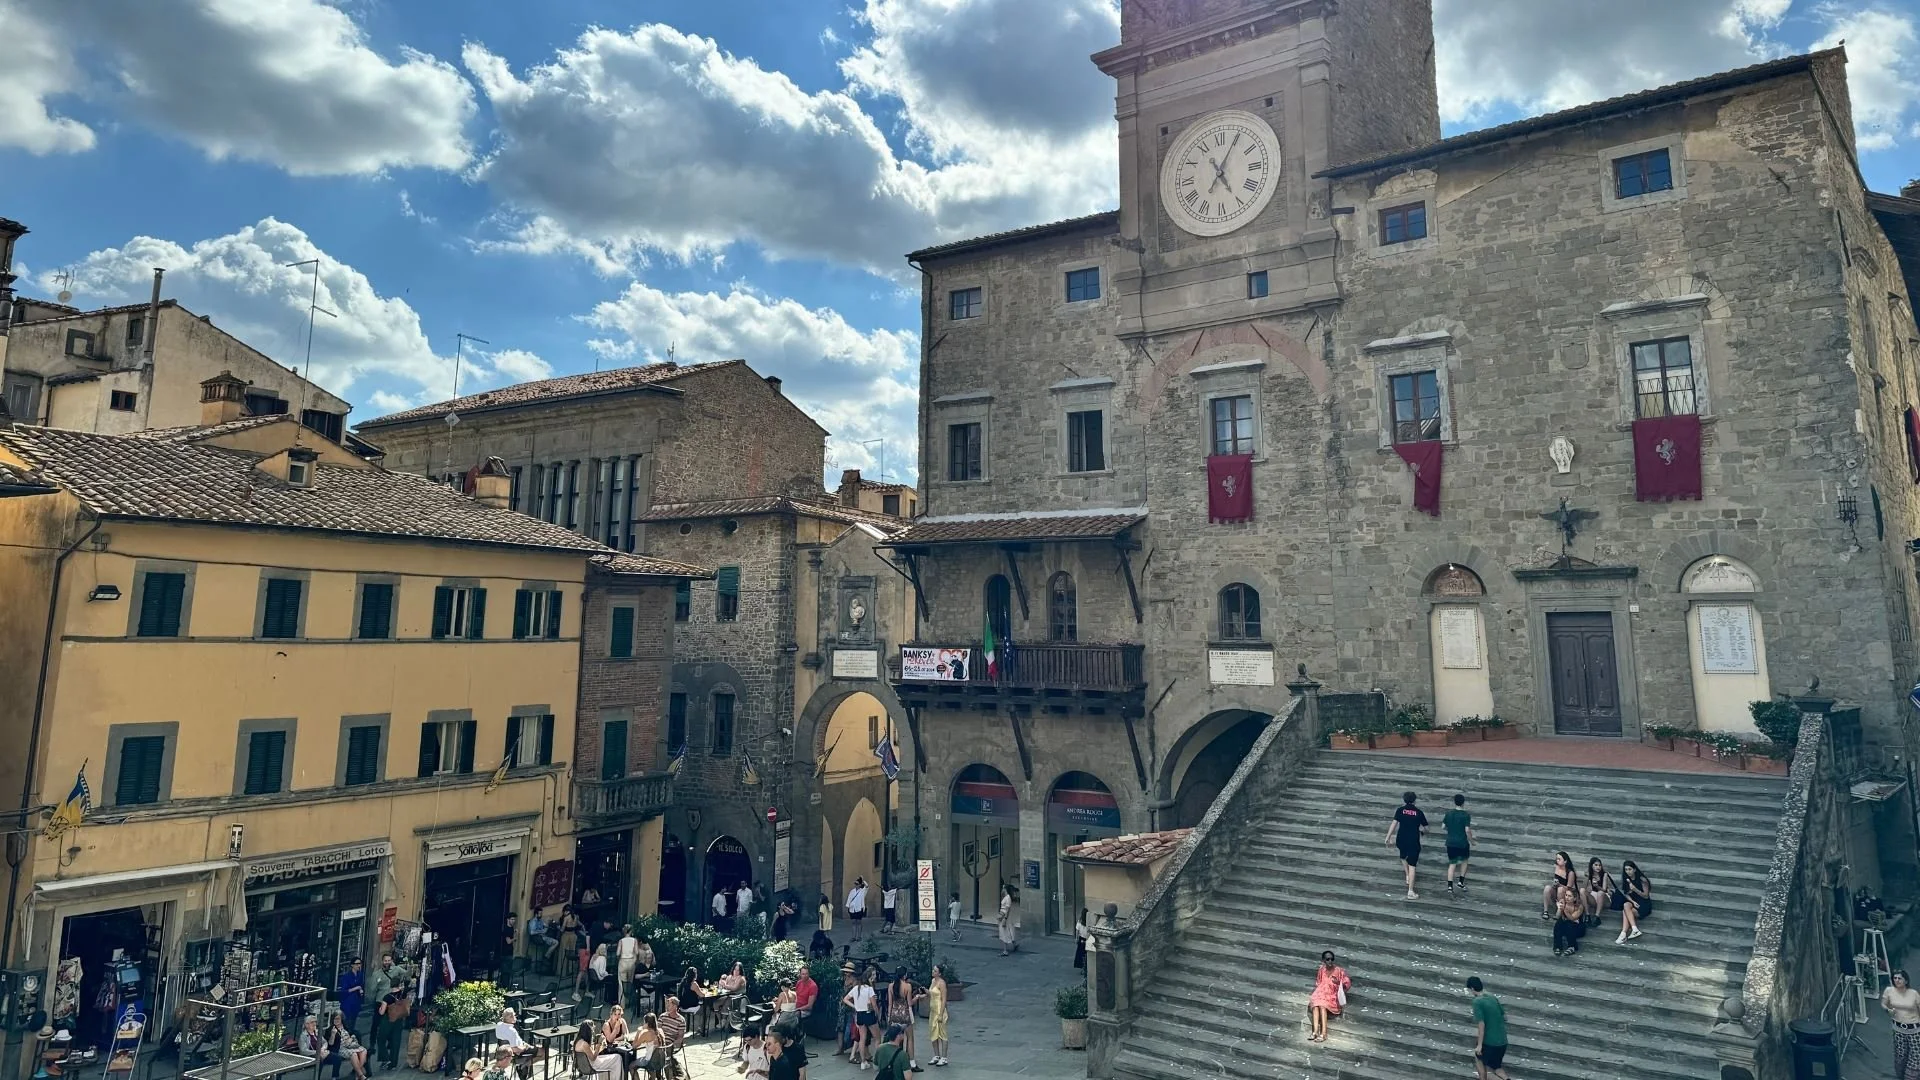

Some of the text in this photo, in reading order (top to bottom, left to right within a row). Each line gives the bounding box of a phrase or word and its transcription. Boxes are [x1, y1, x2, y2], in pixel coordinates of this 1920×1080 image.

[1214, 131, 1225, 147] XII
[1197, 140, 1210, 155] XI
[1185, 159, 1199, 168] X
[1247, 161, 1262, 172] III
[903, 650, 932, 658] BANKSY
[250, 846, 385, 875] Souvenir TABACCHI Lotto
